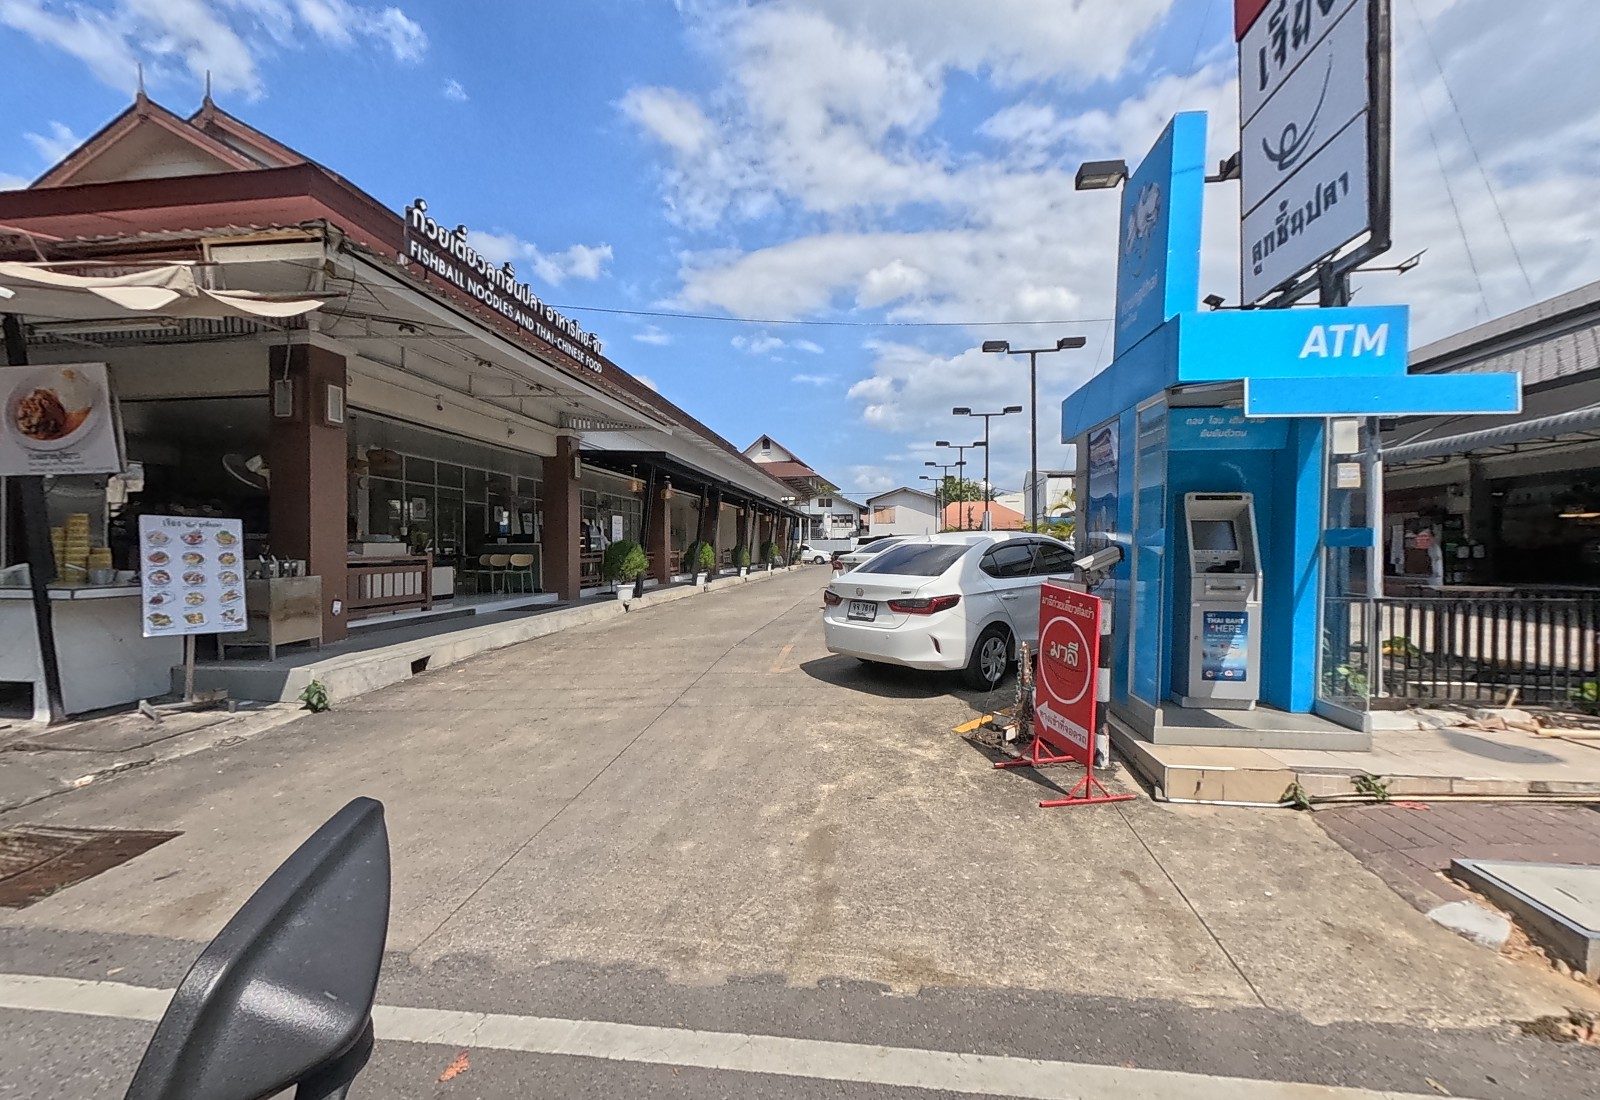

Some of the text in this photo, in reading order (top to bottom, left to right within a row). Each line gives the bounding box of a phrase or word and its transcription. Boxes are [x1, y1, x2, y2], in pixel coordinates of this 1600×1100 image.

[410, 240, 603, 373] FISHBALL NOODLES AND THAI-CHINESE FOOD
[1298, 322, 1389, 359] ATM
[1215, 624, 1242, 633] HERE
[1050, 641, 1079, 667] มาลี
